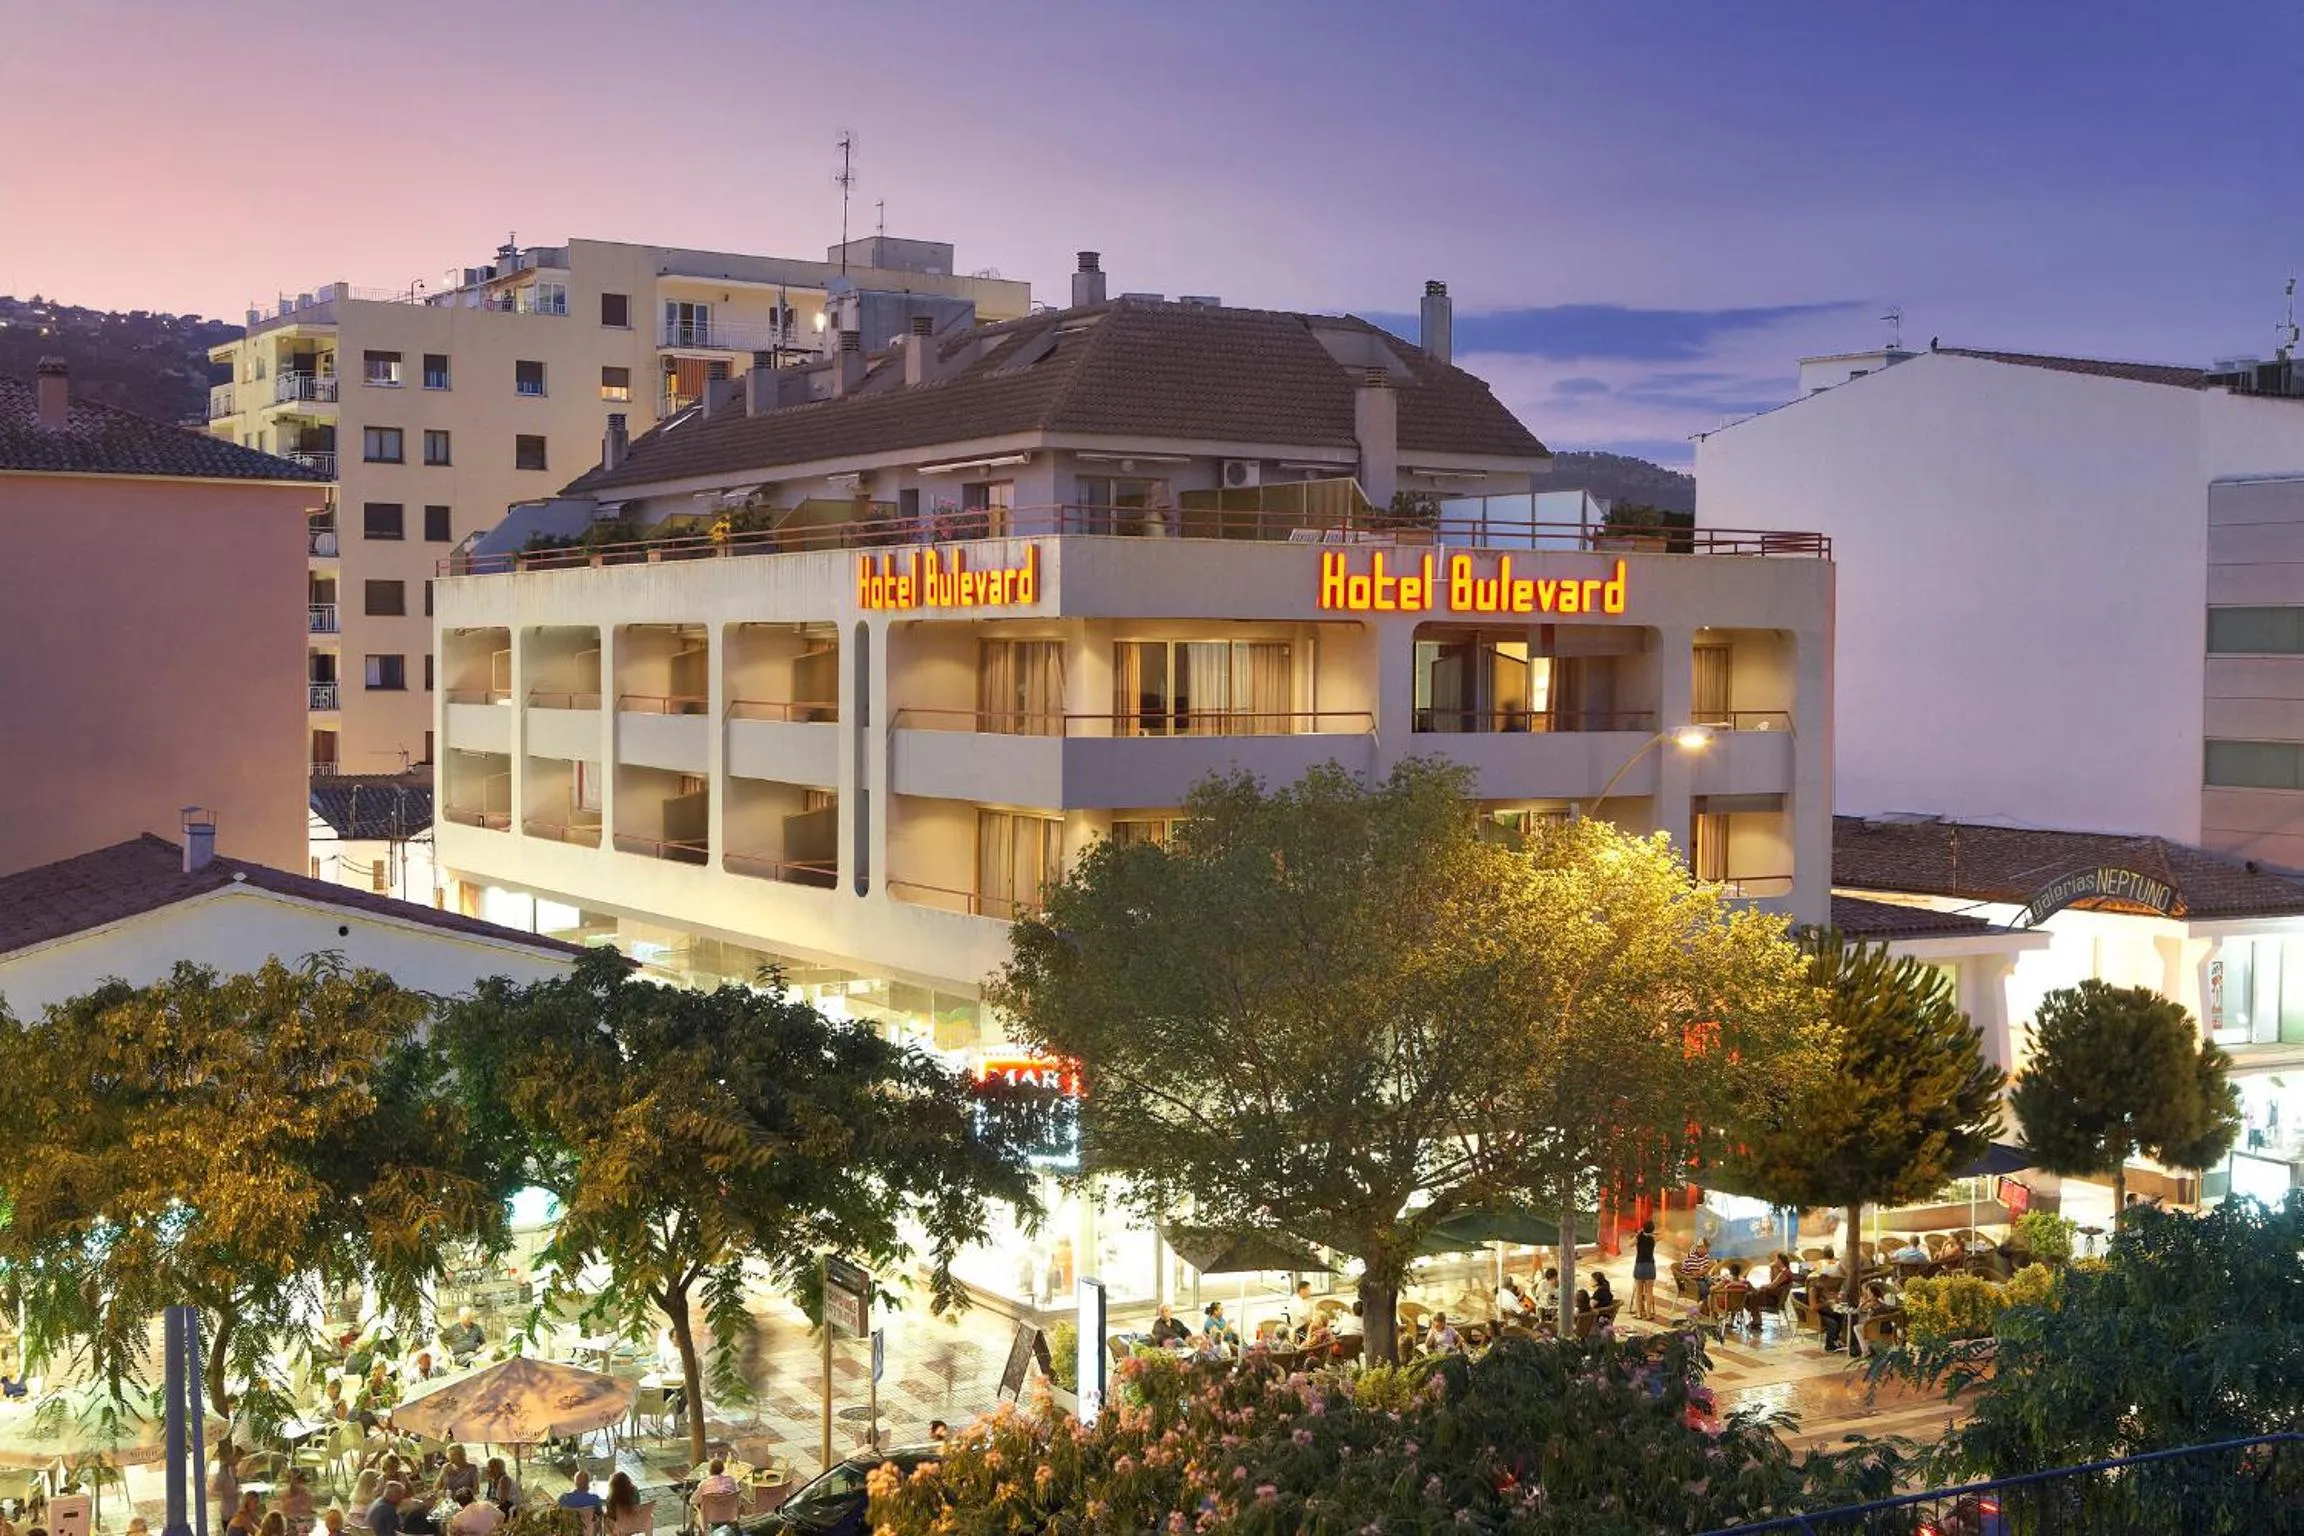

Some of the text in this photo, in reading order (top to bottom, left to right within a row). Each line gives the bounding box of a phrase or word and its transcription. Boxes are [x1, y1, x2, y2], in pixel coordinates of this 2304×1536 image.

[858, 543, 1038, 609] Hotel Bulevard
[1320, 550, 1627, 614] Hotel Bulevard
[2096, 866, 2172, 911] NEPTUNO
